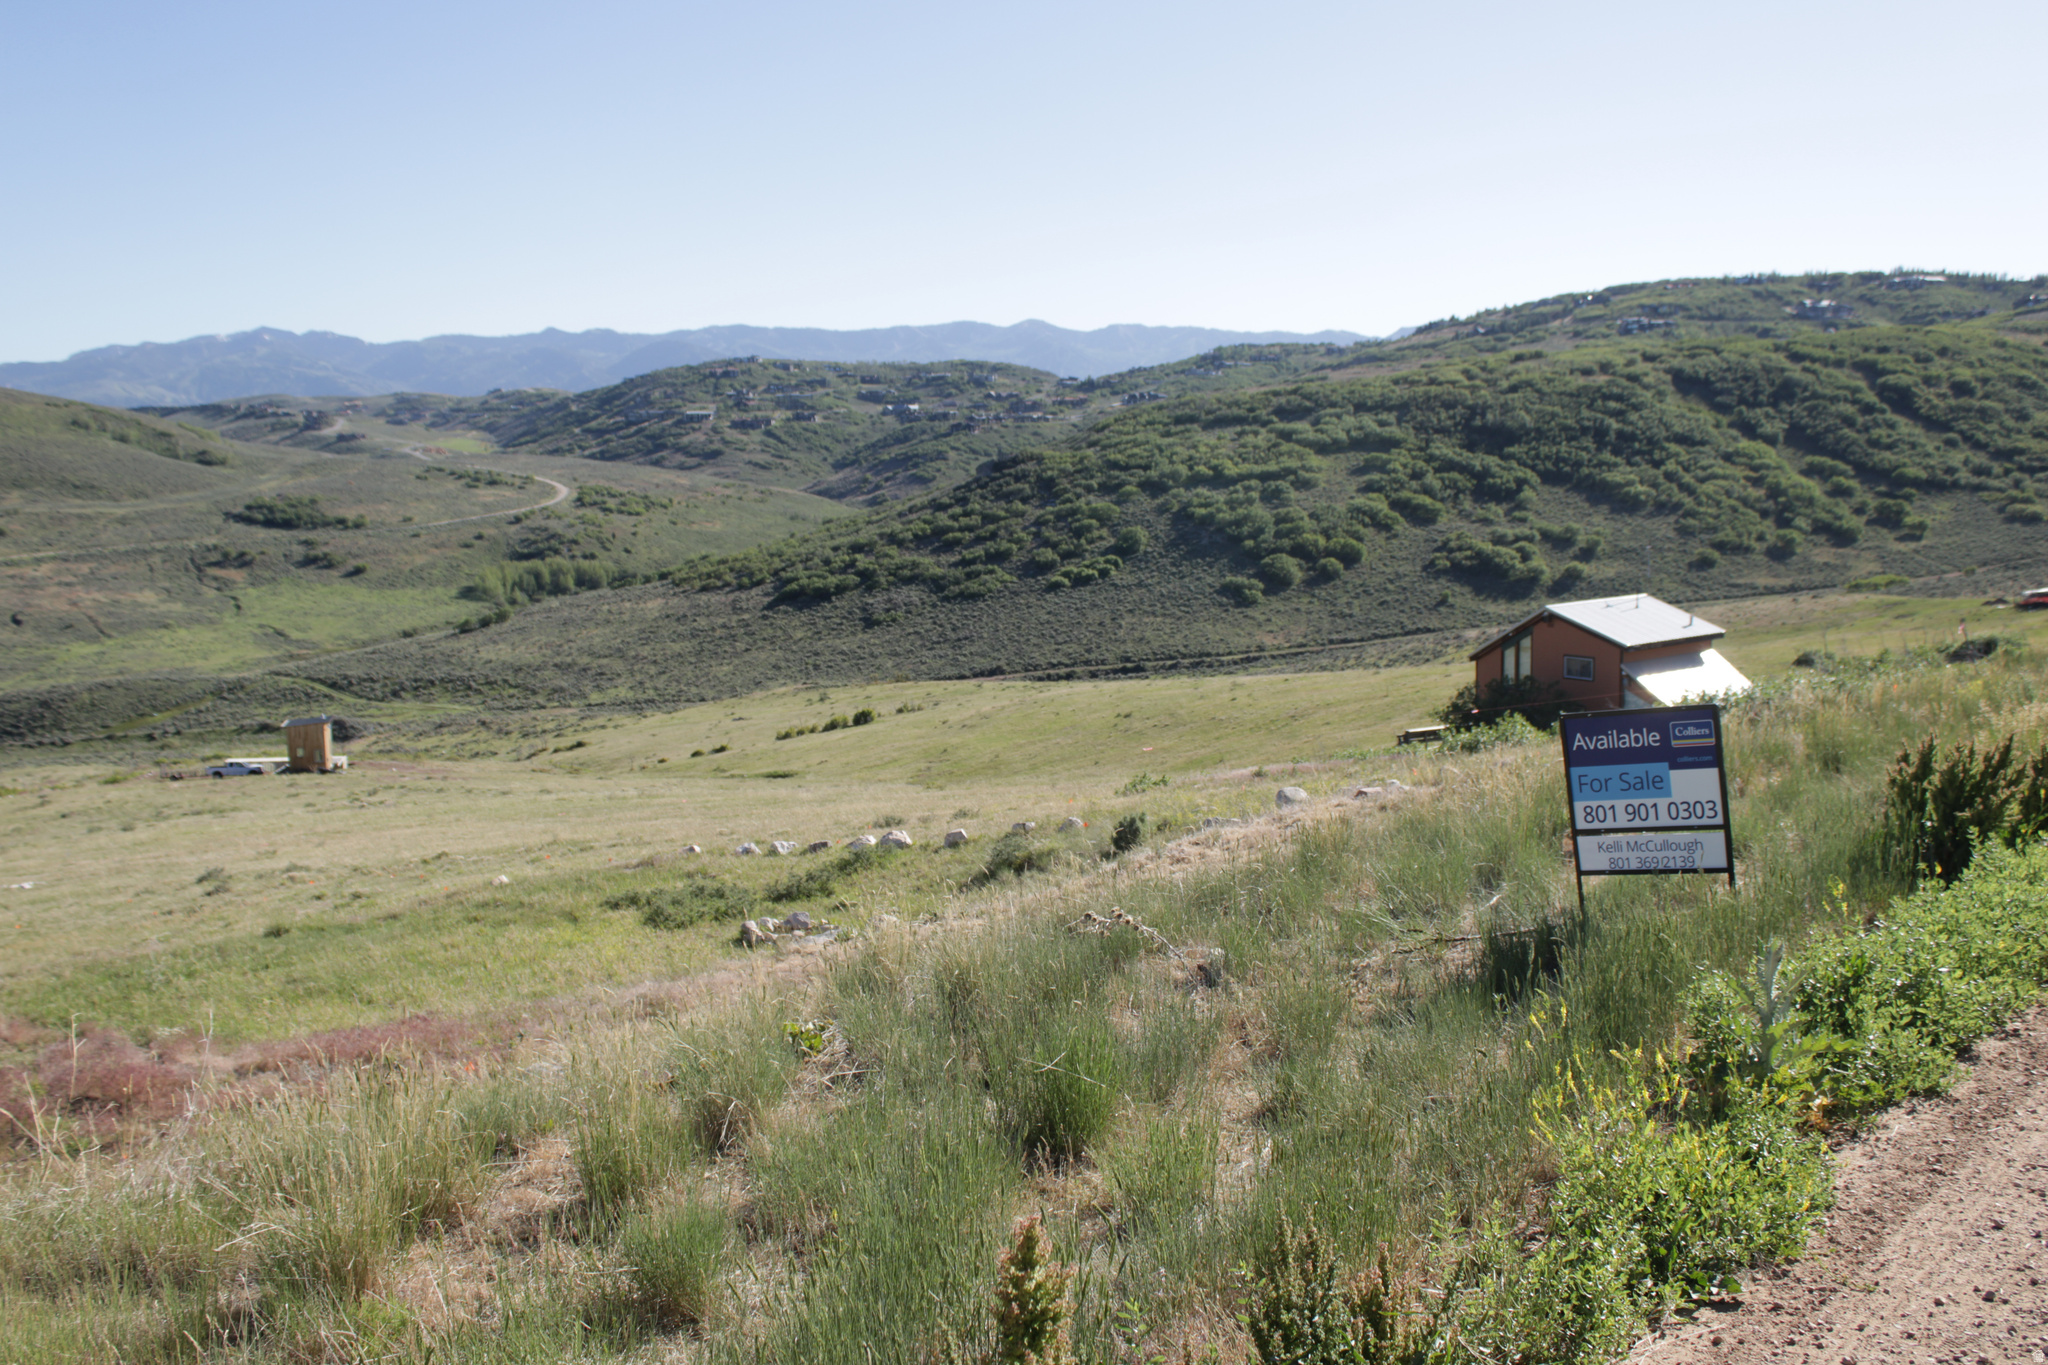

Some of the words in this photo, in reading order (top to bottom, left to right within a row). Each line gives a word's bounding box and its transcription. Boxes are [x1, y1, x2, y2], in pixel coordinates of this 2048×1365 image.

[1573, 728, 1661, 751] Available
[1675, 726, 1709, 736] Colliers
[1578, 774, 1612, 793] For
[1619, 770, 1664, 791] Sale
[1583, 805, 1617, 823] 801
[1624, 803, 1659, 822] 901
[1667, 800, 1718, 820] 0303
[1597, 840, 1623, 853] Kelli
[1626, 839, 1703, 854] McCullough
[1609, 858, 1630, 869] 801
[1636, 857, 1659, 868] 369
[1663, 856, 1695, 868] 2139
